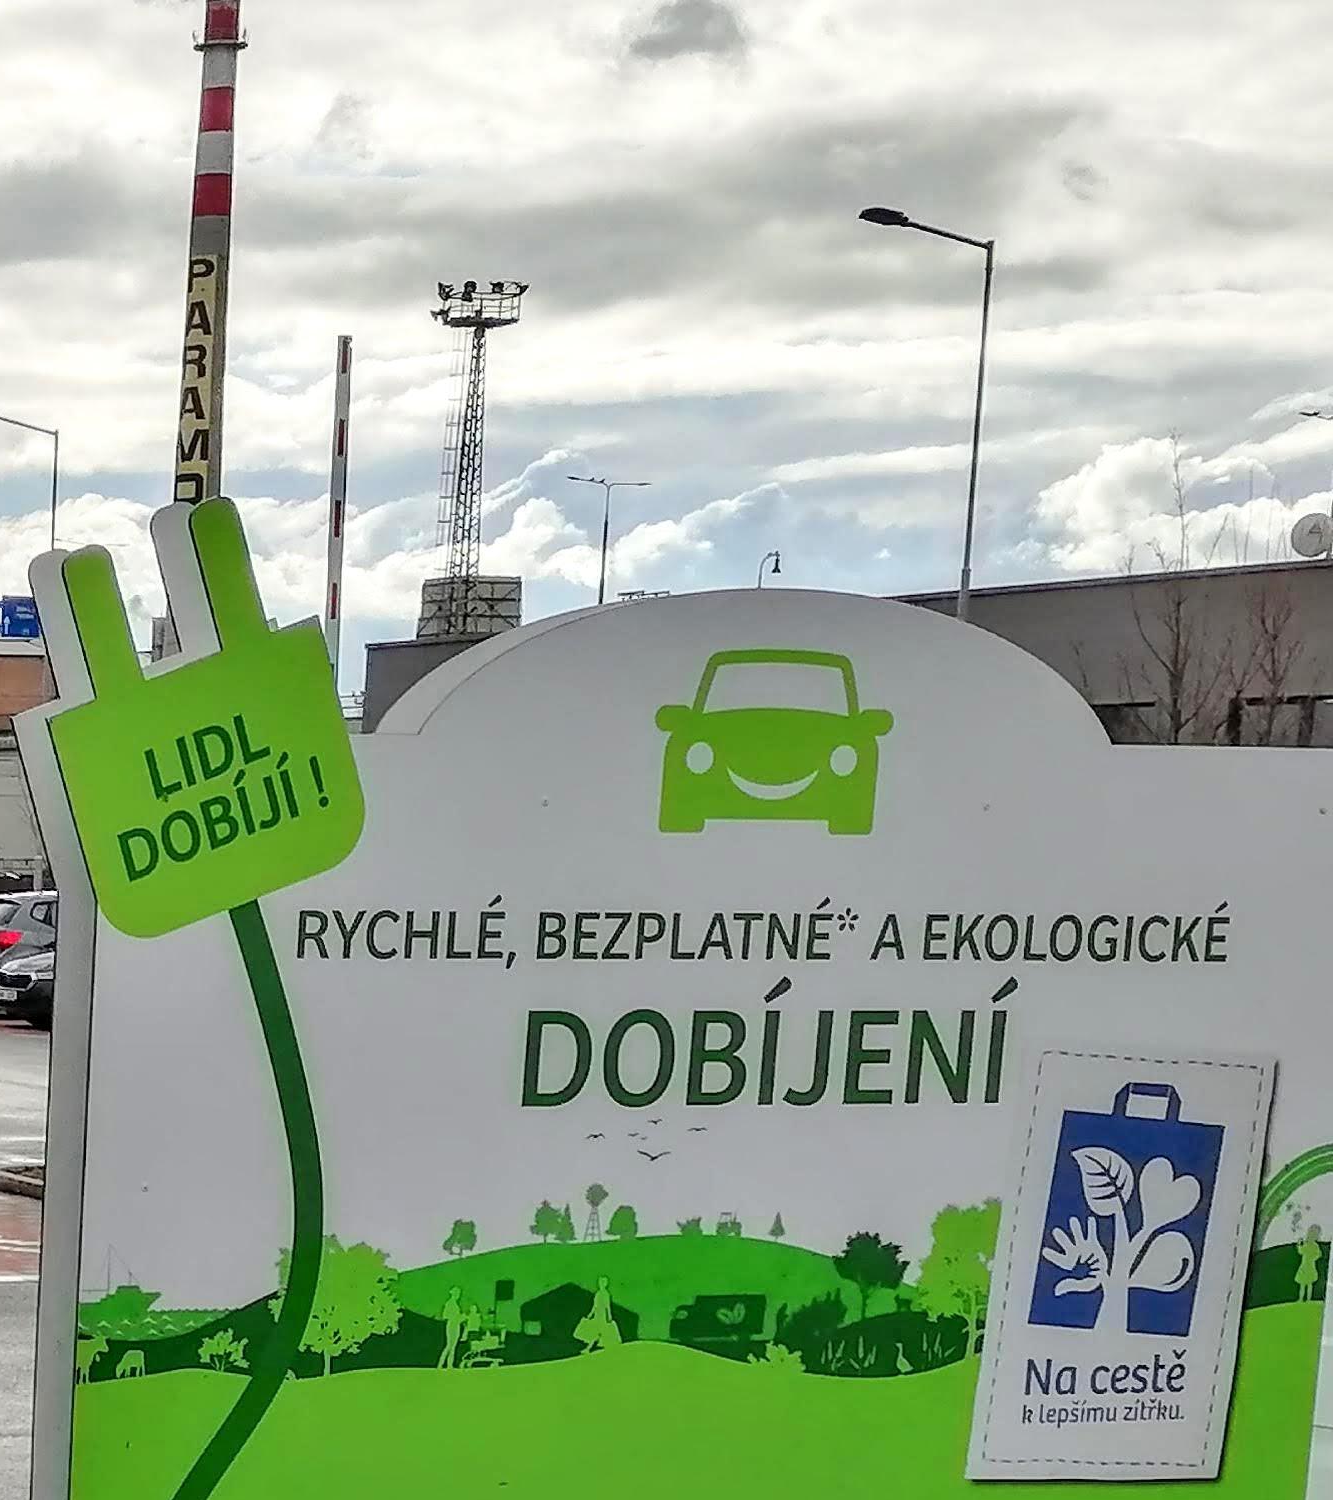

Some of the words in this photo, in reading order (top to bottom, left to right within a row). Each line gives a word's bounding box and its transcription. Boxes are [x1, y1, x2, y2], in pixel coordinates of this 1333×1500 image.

[175, 257, 216, 503] PARAMO
[143, 714, 271, 801] LIDL
[116, 752, 300, 883] DOBÍJÍ
[295, 895, 517, 969] RYCHLÉ,
[870, 913, 905, 961] A
[923, 902, 1231, 963] EKOLOGICKÉ
[522, 976, 1018, 1106] DOBÍJENÍ
[1022, 1401, 1035, 1424] k
[1039, 1398, 1117, 1428] lepšímu
[1123, 1397, 1185, 1422] zítřku.
[1024, 1357, 1078, 1396] Na
[1090, 1348, 1187, 1395] cestě
